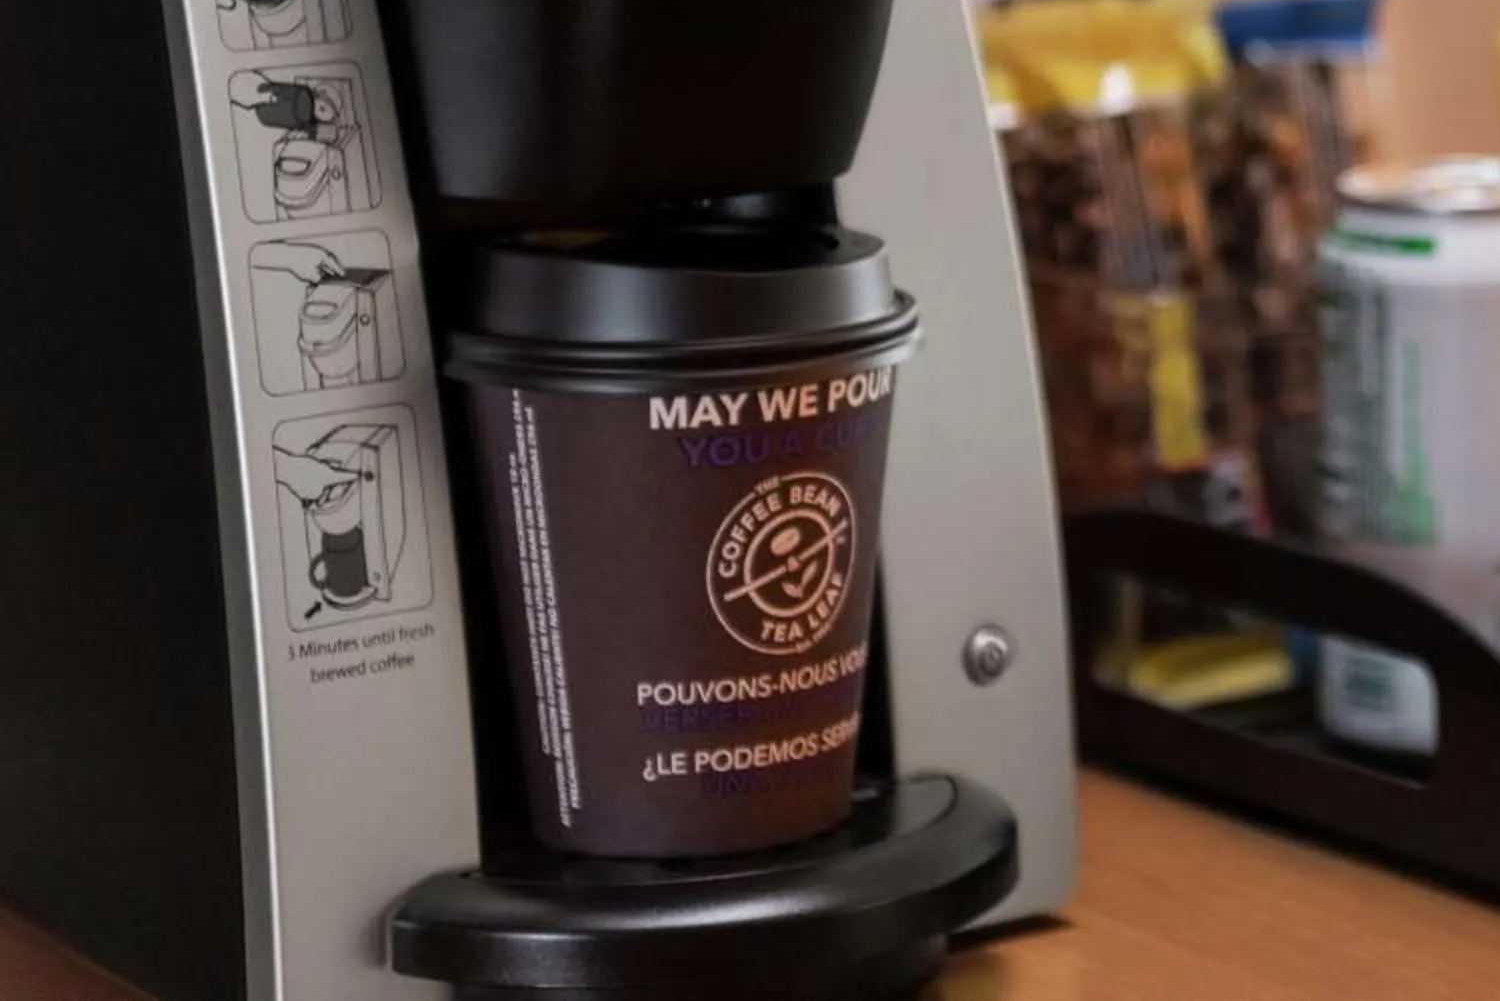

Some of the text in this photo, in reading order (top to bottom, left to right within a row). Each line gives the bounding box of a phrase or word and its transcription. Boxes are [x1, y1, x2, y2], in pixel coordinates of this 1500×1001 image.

[650, 391, 750, 430] MAY
[757, 384, 818, 422] WE
[680, 431, 770, 468] YOU
[718, 485, 841, 578] COFFEE BEAN
[299, 637, 359, 658] Minutes
[362, 629, 395, 648] until
[399, 623, 435, 642] fresh
[761, 621, 804, 643] TEA
[310, 652, 415, 683] brewed coffee
[637, 660, 837, 707] POUVONS-NOUS
[642, 753, 687, 782] ¿LE
[695, 732, 818, 774] PODEMOS
